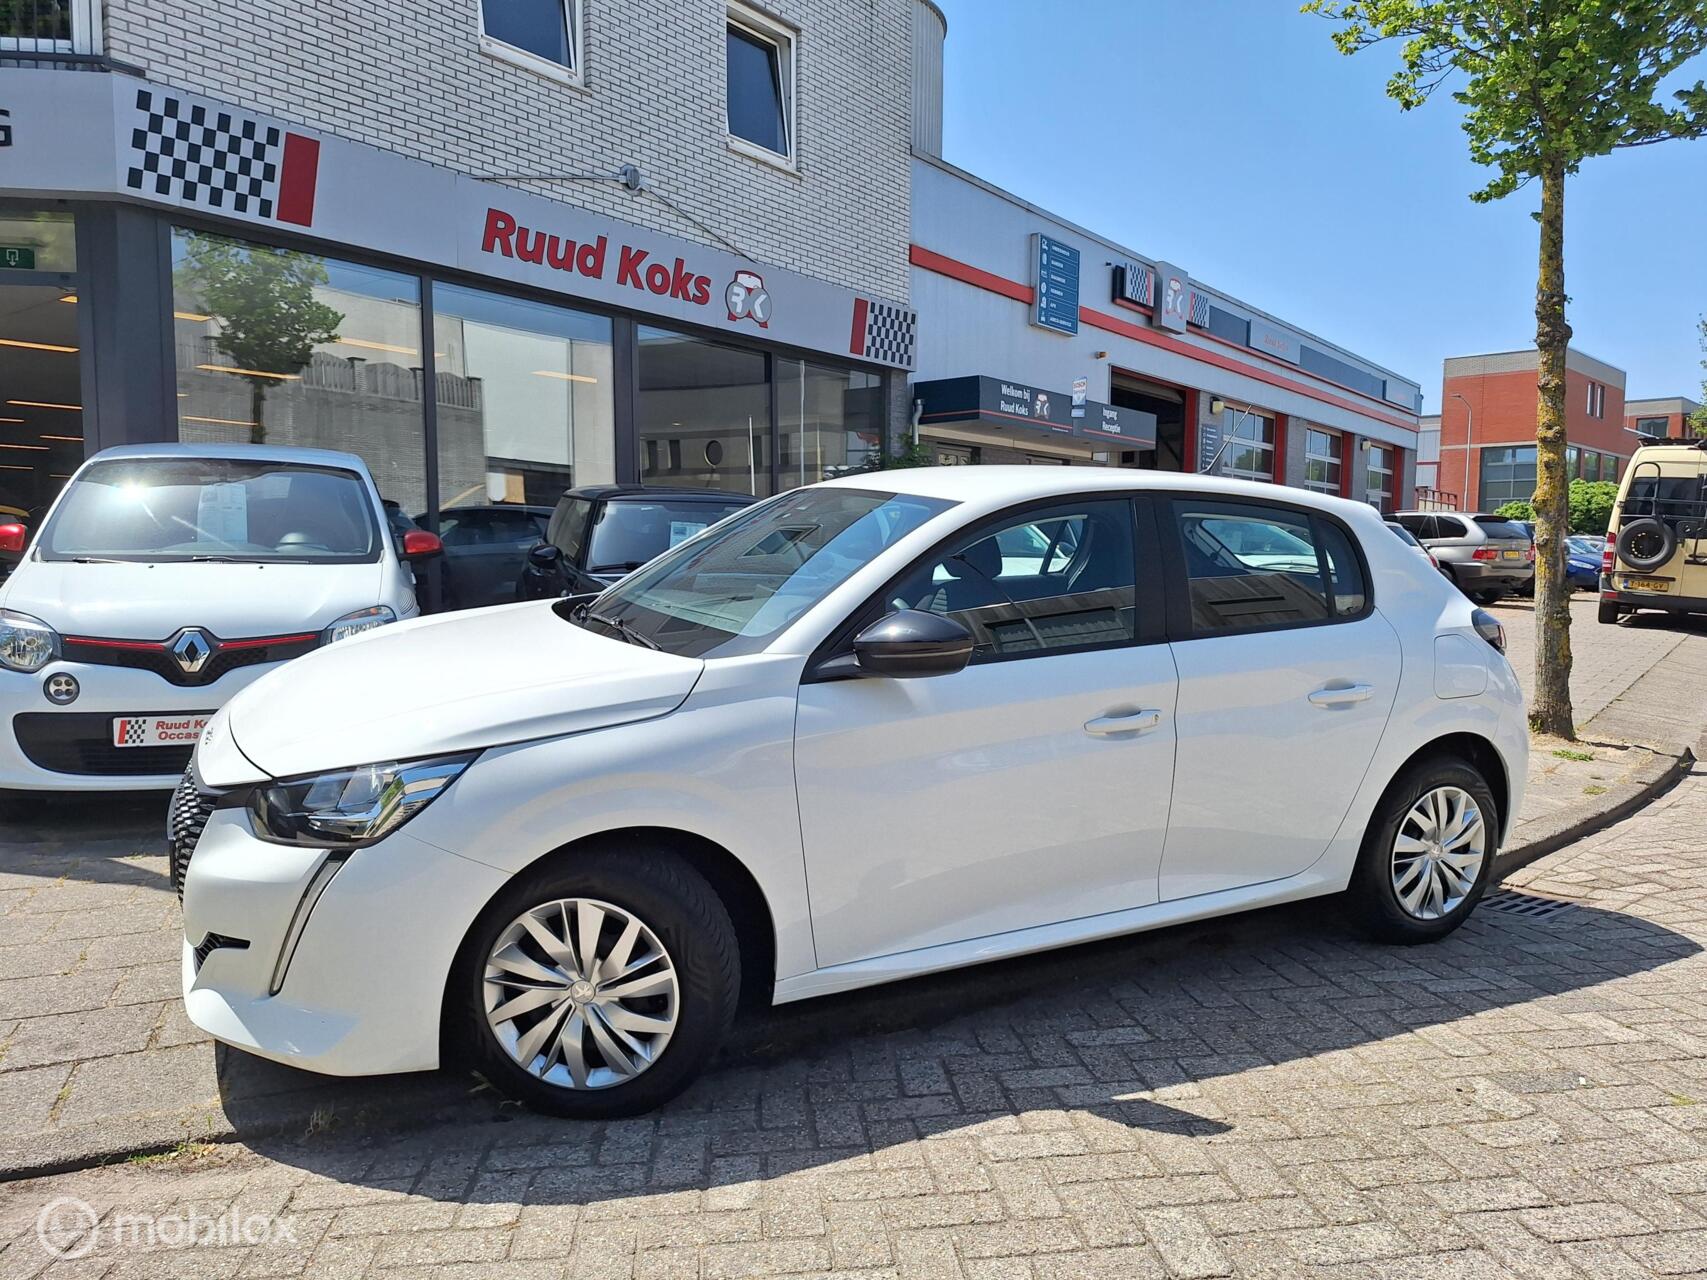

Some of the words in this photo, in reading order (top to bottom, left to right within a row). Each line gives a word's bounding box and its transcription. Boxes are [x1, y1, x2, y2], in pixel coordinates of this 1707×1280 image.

[481, 207, 608, 279] Ruud
[616, 245, 712, 306] Koks
[1001, 384, 1023, 399] Welkom
[1000, 400, 1015, 413] Ruud
[1015, 403, 1029, 416] Koks
[1102, 407, 1118, 421] Ingang
[1102, 421, 1121, 434] Receptie
[156, 720, 191, 730] Ruud
